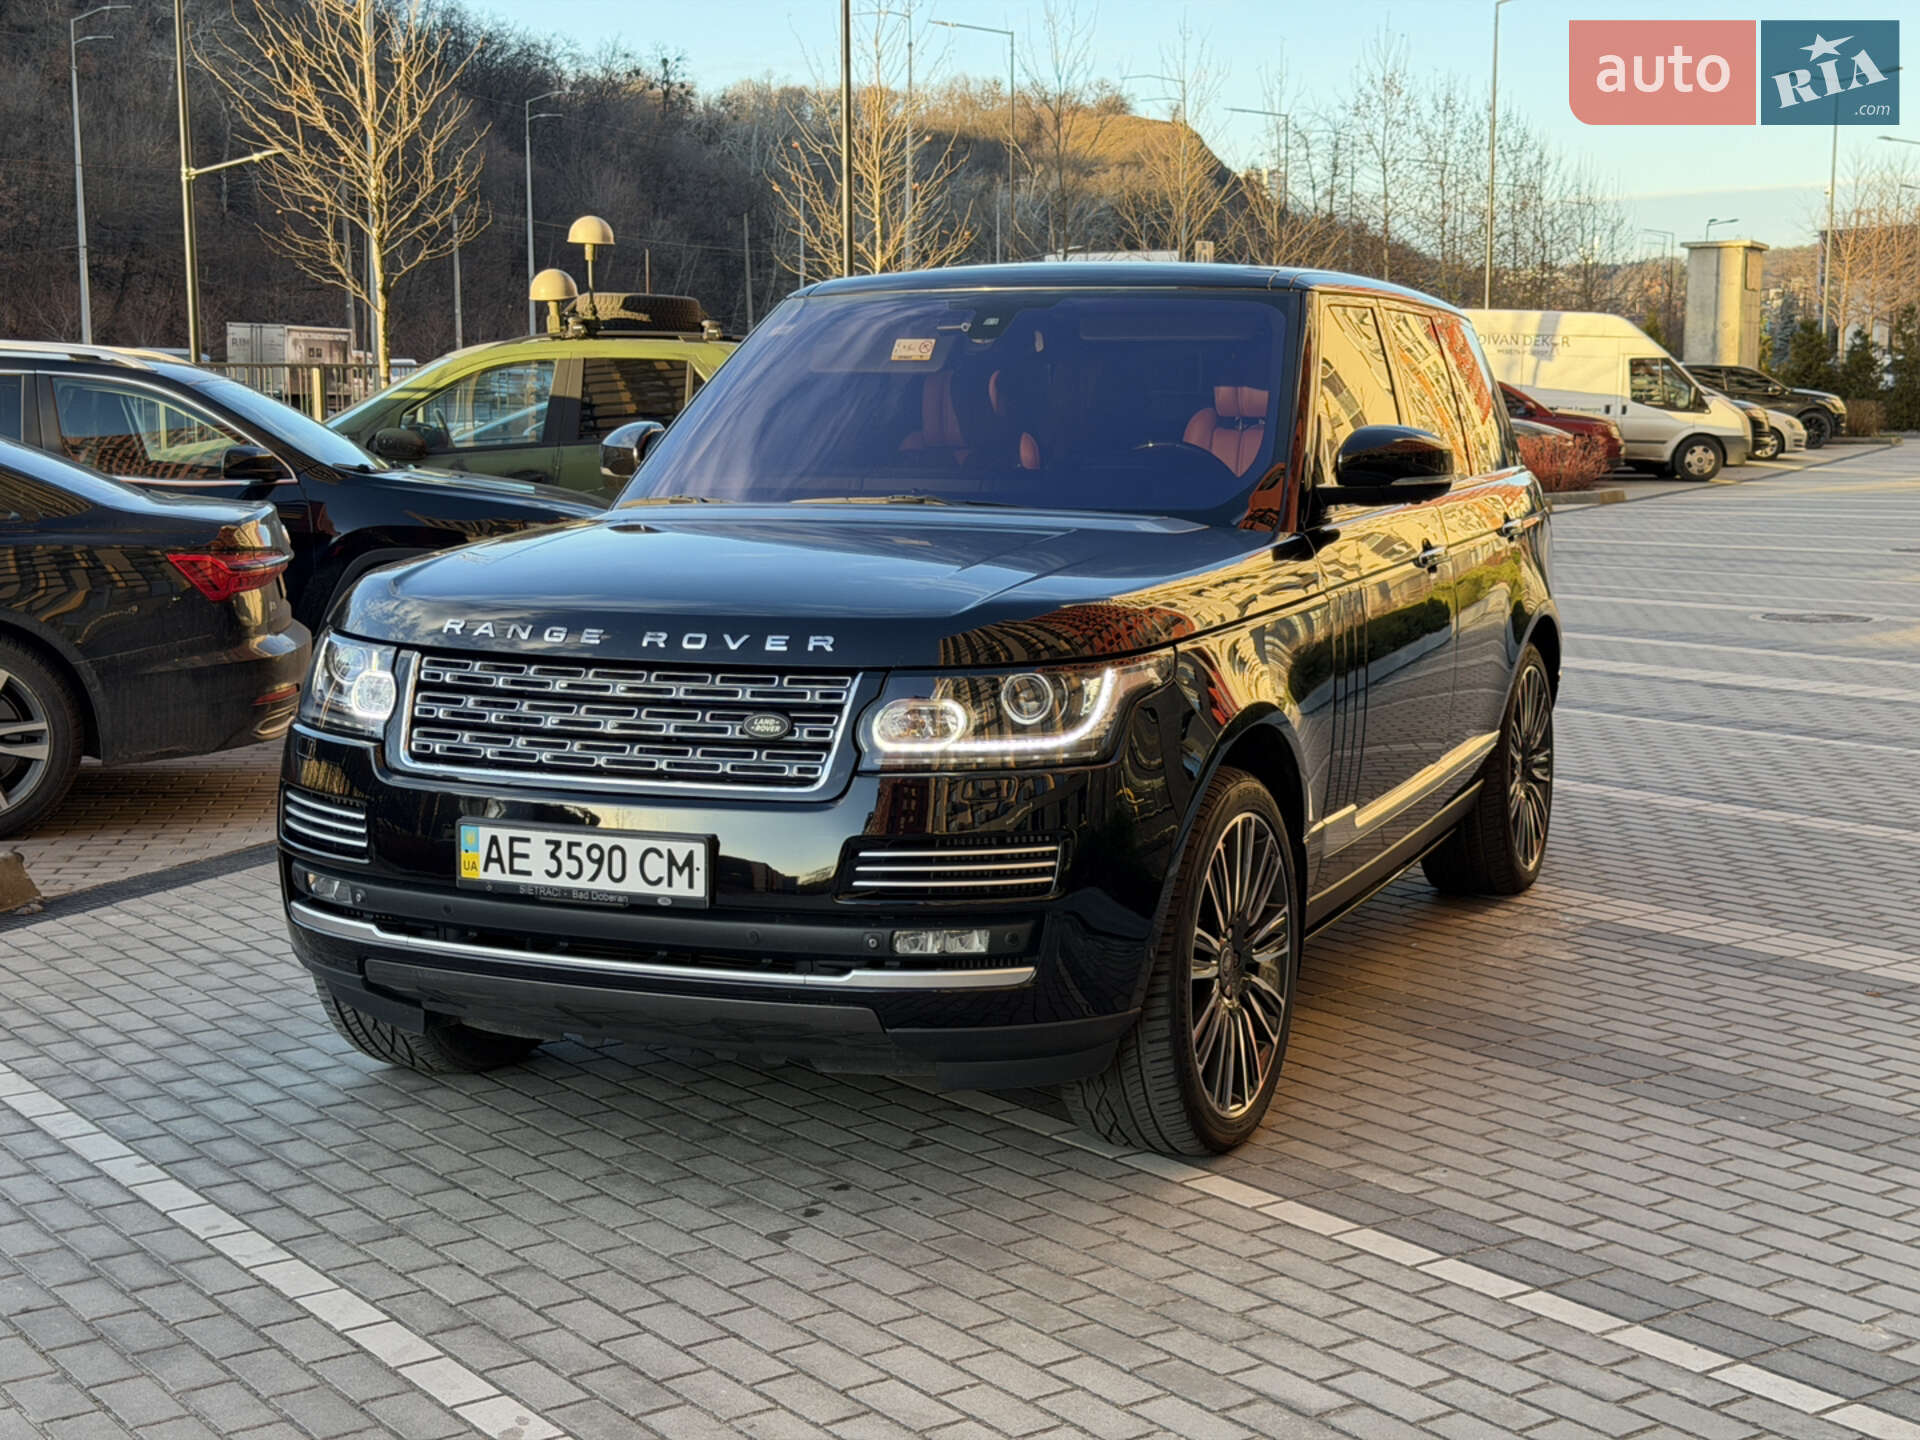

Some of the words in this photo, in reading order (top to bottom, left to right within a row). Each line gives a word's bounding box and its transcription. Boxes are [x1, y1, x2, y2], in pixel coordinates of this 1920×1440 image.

[1522, 334, 1571, 348] DEKR
[442, 618, 605, 646] RANGE
[641, 631, 836, 653] ROVER
[463, 860, 479, 873] UA
[482, 834, 533, 877] AE
[543, 839, 627, 884] 3590
[638, 846, 696, 890] CM
